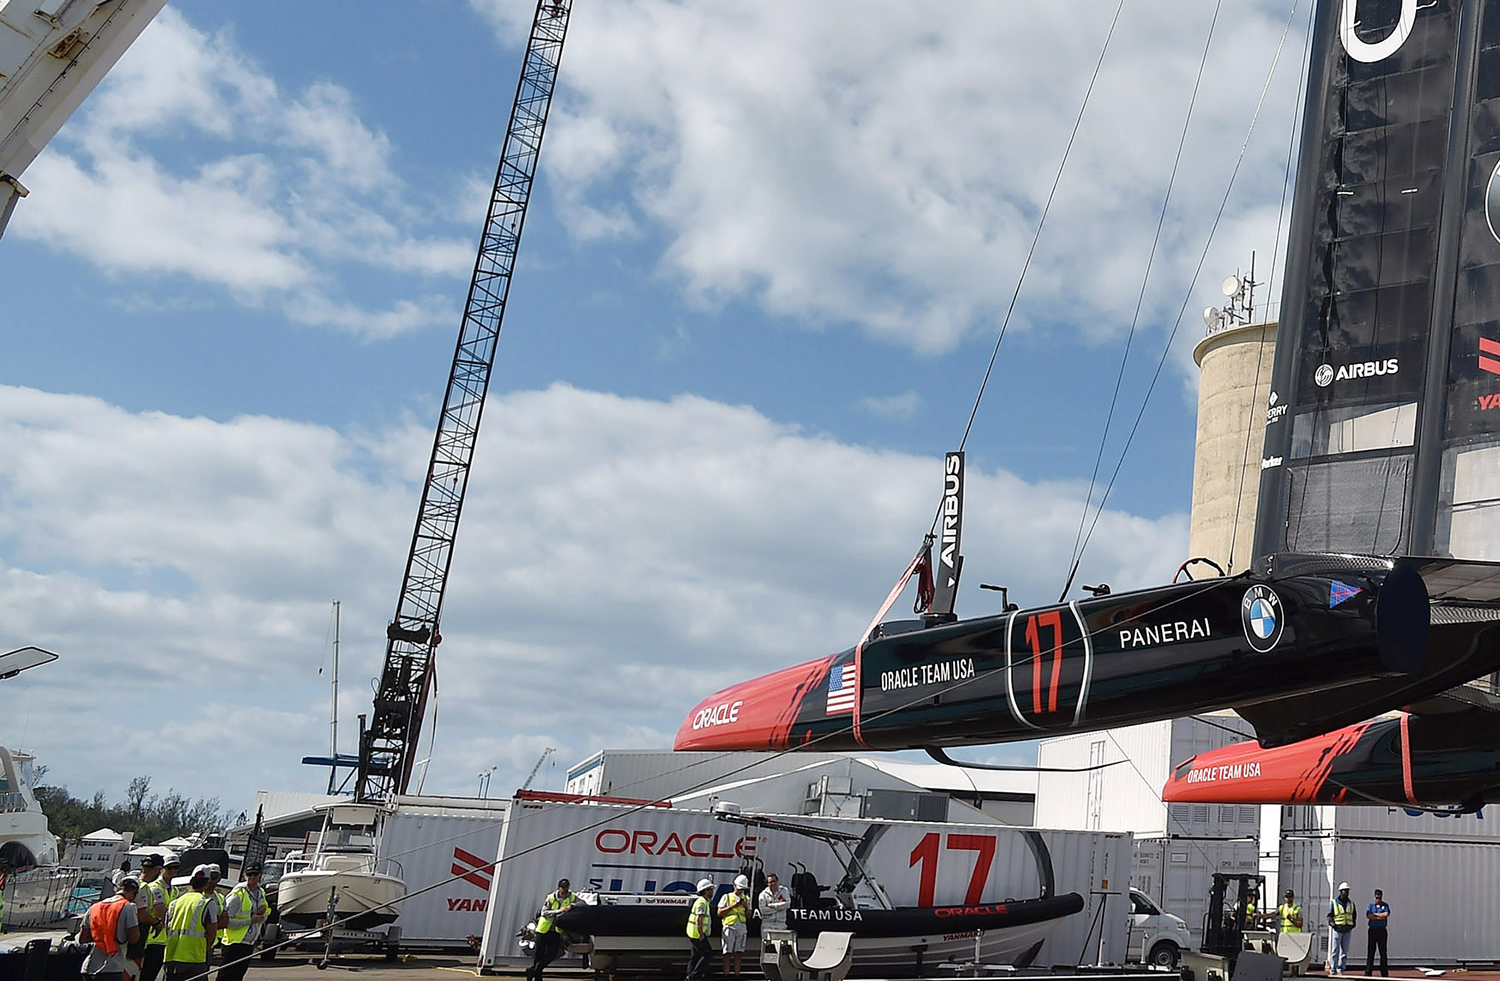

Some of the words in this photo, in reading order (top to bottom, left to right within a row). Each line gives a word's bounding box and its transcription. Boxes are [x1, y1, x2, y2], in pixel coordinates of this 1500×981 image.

[1335, 358, 1399, 381] AIRBUS
[1266, 404, 1289, 420] ERRY
[941, 454, 960, 569] AIRBUS
[1243, 587, 1278, 610] BMW
[1119, 617, 1212, 649] PANERAI
[1025, 610, 1062, 714] 17
[881, 667, 918, 692] ORACLE
[920, 662, 950, 685] TEAM
[952, 658, 975, 680] USA
[692, 700, 742, 730] ORACLE
[1187, 766, 1217, 784] ORACLE
[1218, 764, 1242, 780] TEAM
[1243, 762, 1261, 778] USA
[595, 829, 757, 859] ORACLE
[909, 832, 996, 908] 17
[447, 898, 488, 912] YAN
[656, 898, 688, 906] YANMAR
[934, 904, 1008, 919] ORACLE
[791, 908, 831, 921] TEAM
[834, 909, 863, 921] USA
